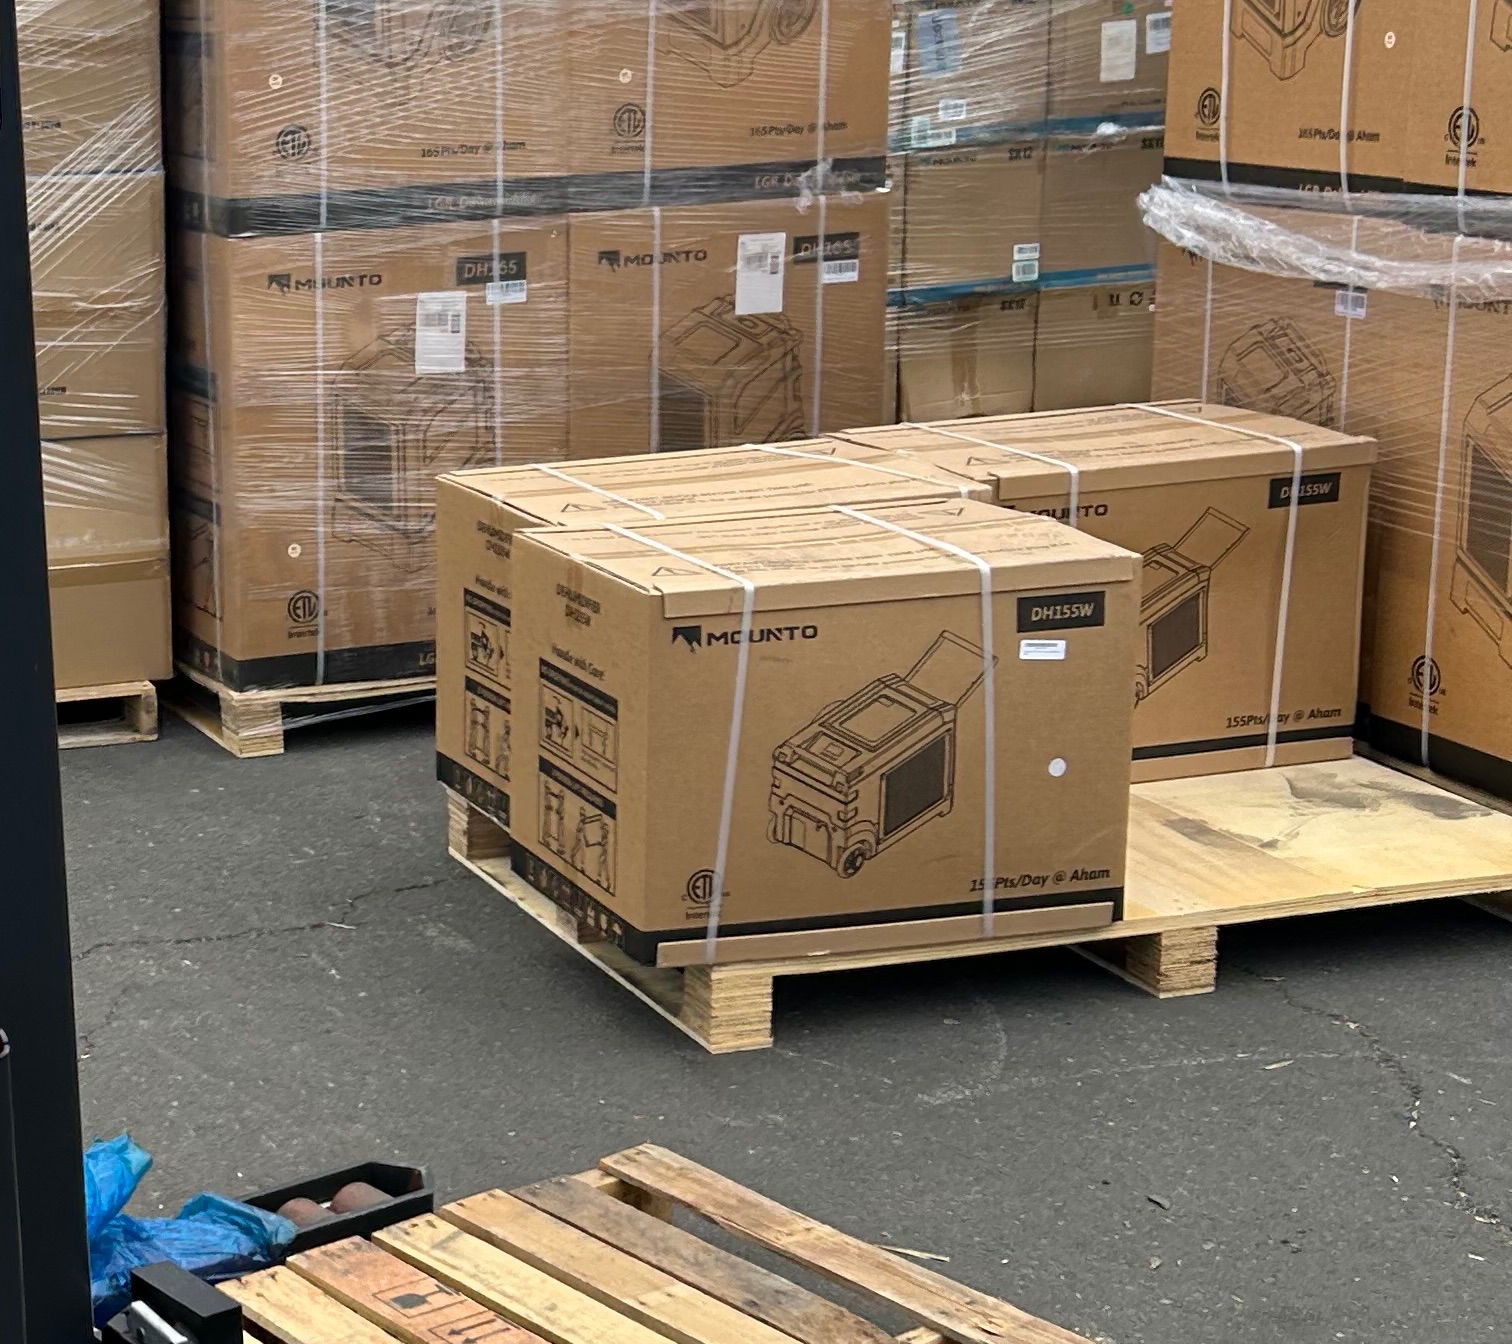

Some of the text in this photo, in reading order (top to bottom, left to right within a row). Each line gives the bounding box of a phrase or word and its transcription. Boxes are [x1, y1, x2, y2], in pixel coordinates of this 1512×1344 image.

[1030, 602, 1096, 622] DH155W
[1307, 707, 1342, 721] Aham
[969, 873, 1051, 893] 15Pts/Day
[1070, 867, 1111, 882] Aham
